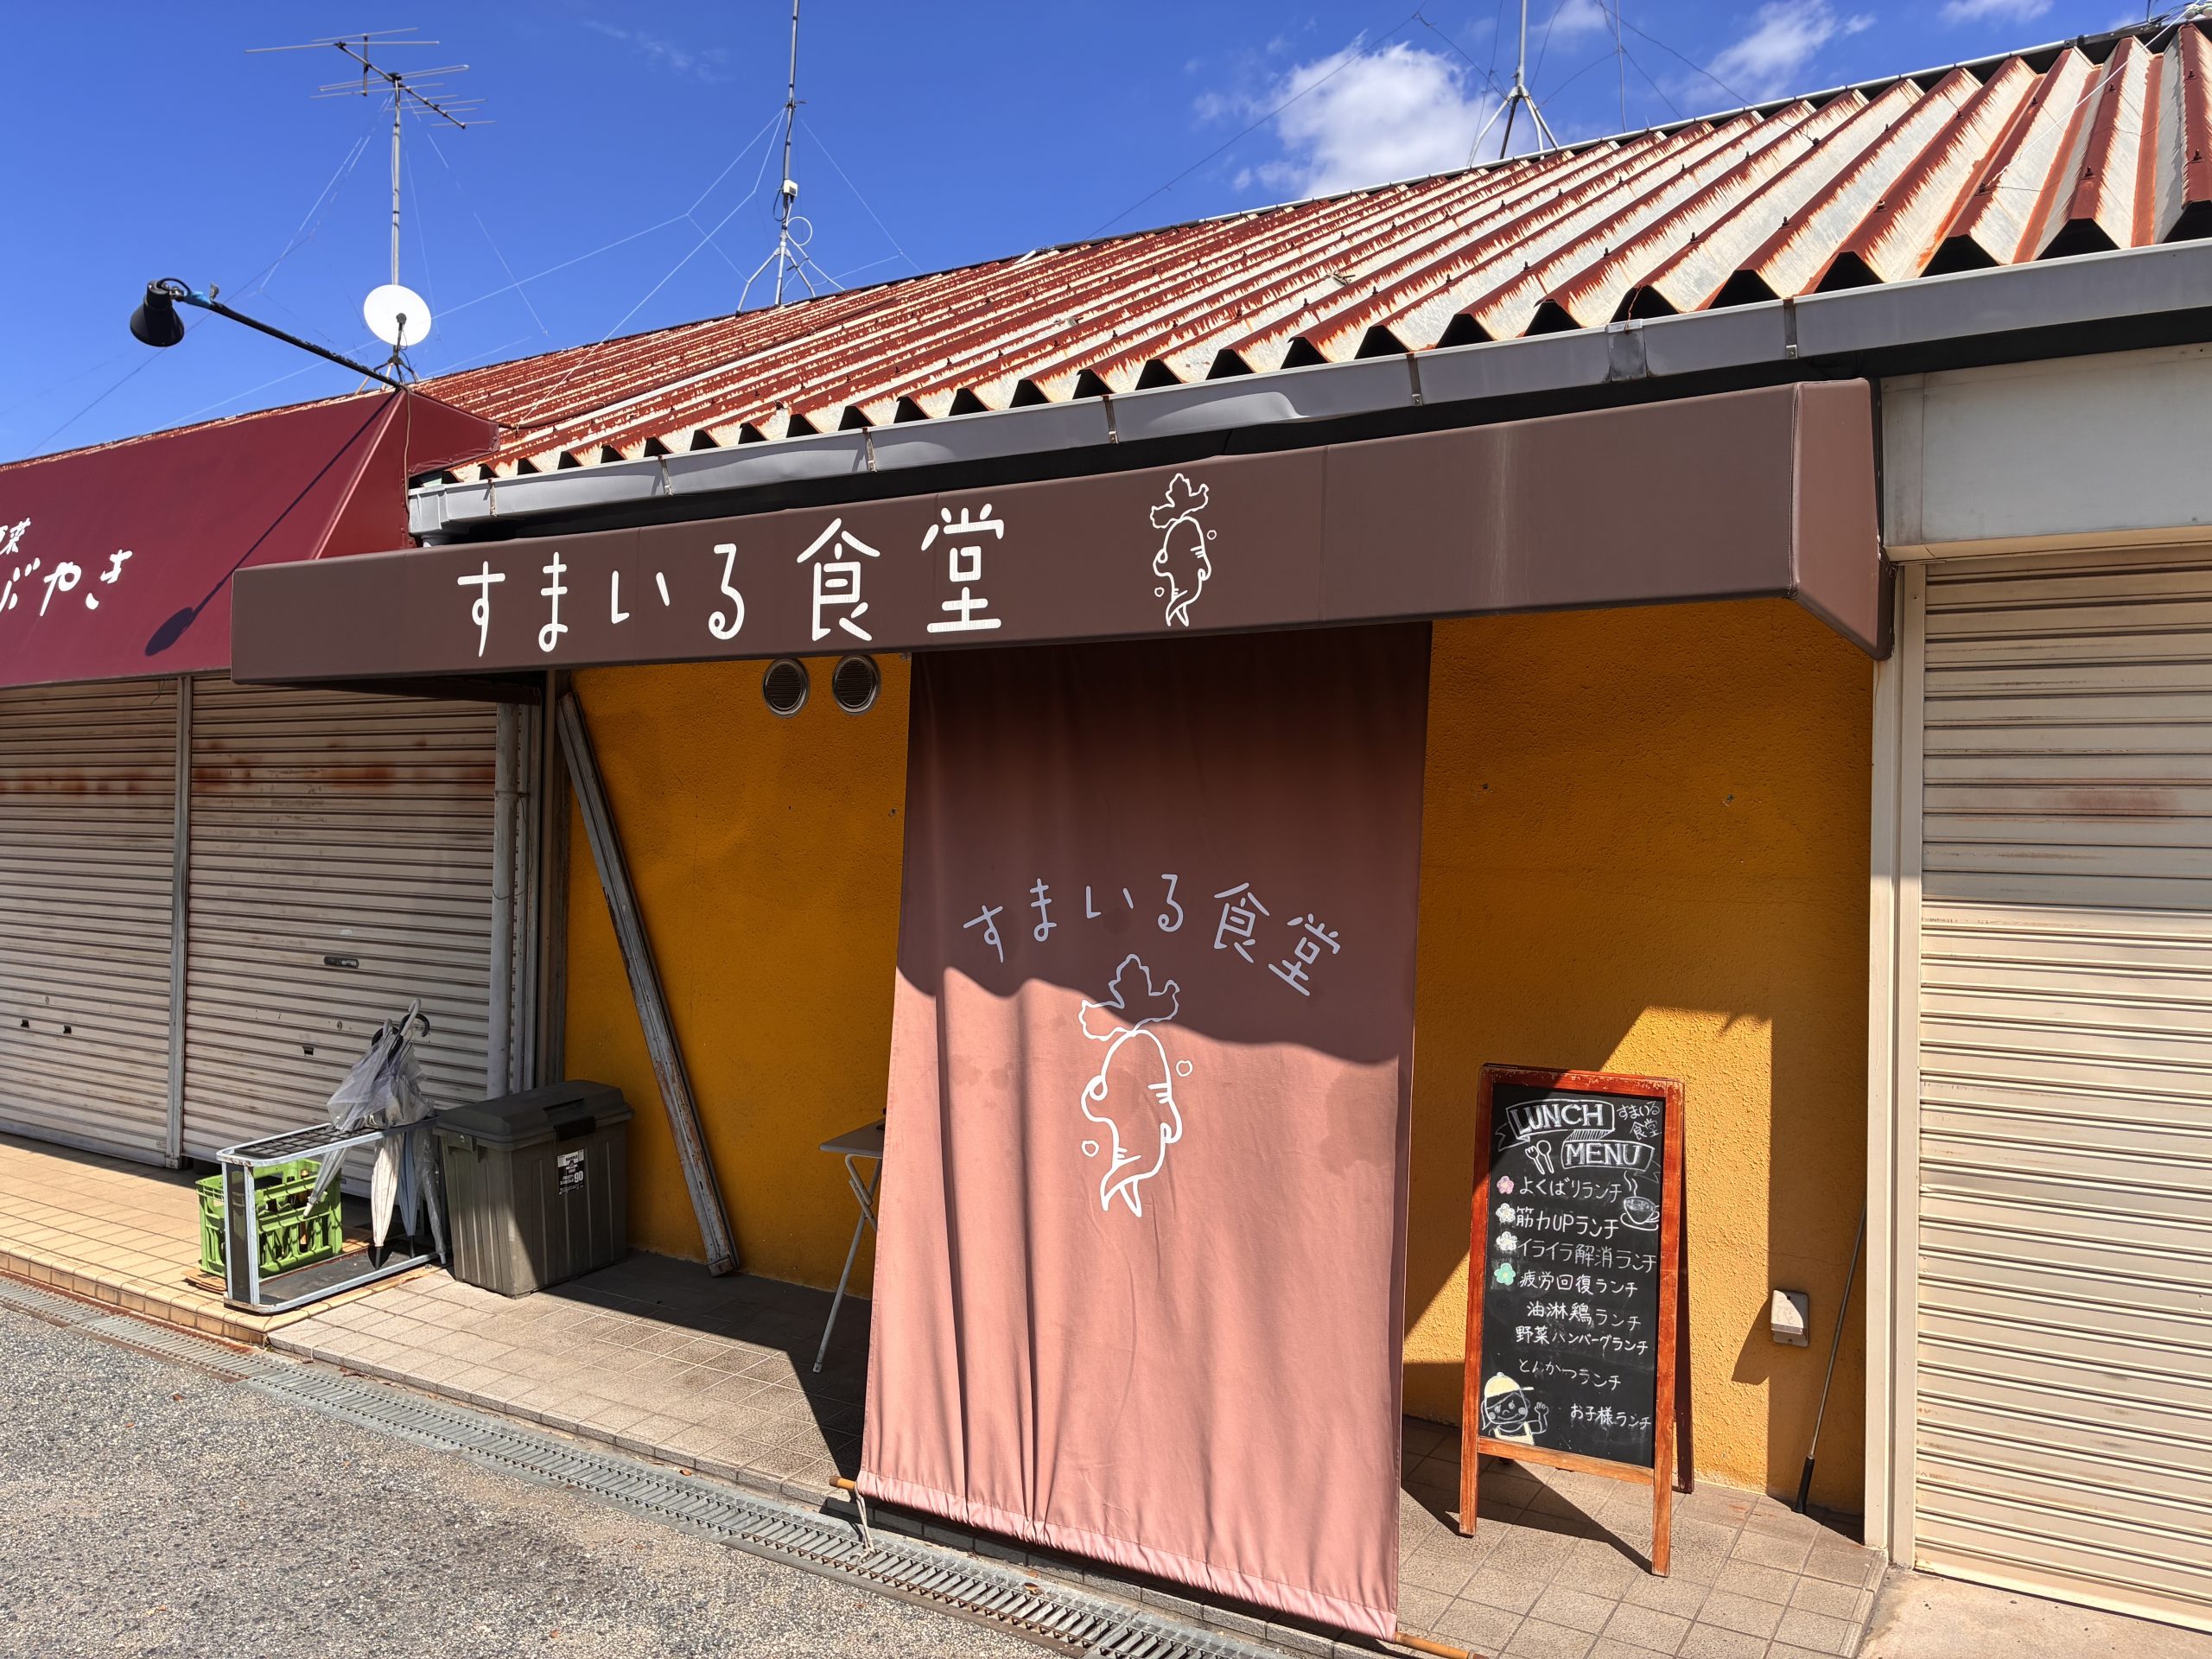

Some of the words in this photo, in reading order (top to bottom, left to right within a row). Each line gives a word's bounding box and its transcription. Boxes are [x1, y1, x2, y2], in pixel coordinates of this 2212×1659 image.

[456, 503, 1005, 657] すまいる食堂
[963, 873, 1341, 997] すまいる食堂
[1510, 1103, 1605, 1135] LUNCH
[1617, 1101, 1661, 1121] すまいる
[1630, 1119, 1662, 1141] 食堂
[1565, 1142, 1642, 1166] MENU
[574, 1171, 584, 1183] 90
[1519, 1176, 1623, 1204] よくばりランチ
[1516, 1206, 1620, 1240] 筋力UPランチ
[1517, 1237, 1657, 1274] イライラ解消ランチ
[1519, 1269, 1638, 1298] 疲労回復ランチ
[1526, 1300, 1643, 1332] 油淋鶏ランチ
[1515, 1325, 1649, 1356] 野菜ハンバーグランチ
[1518, 1358, 1621, 1391] とんかつランチ
[1570, 1403, 1653, 1431] お子様ランチ
